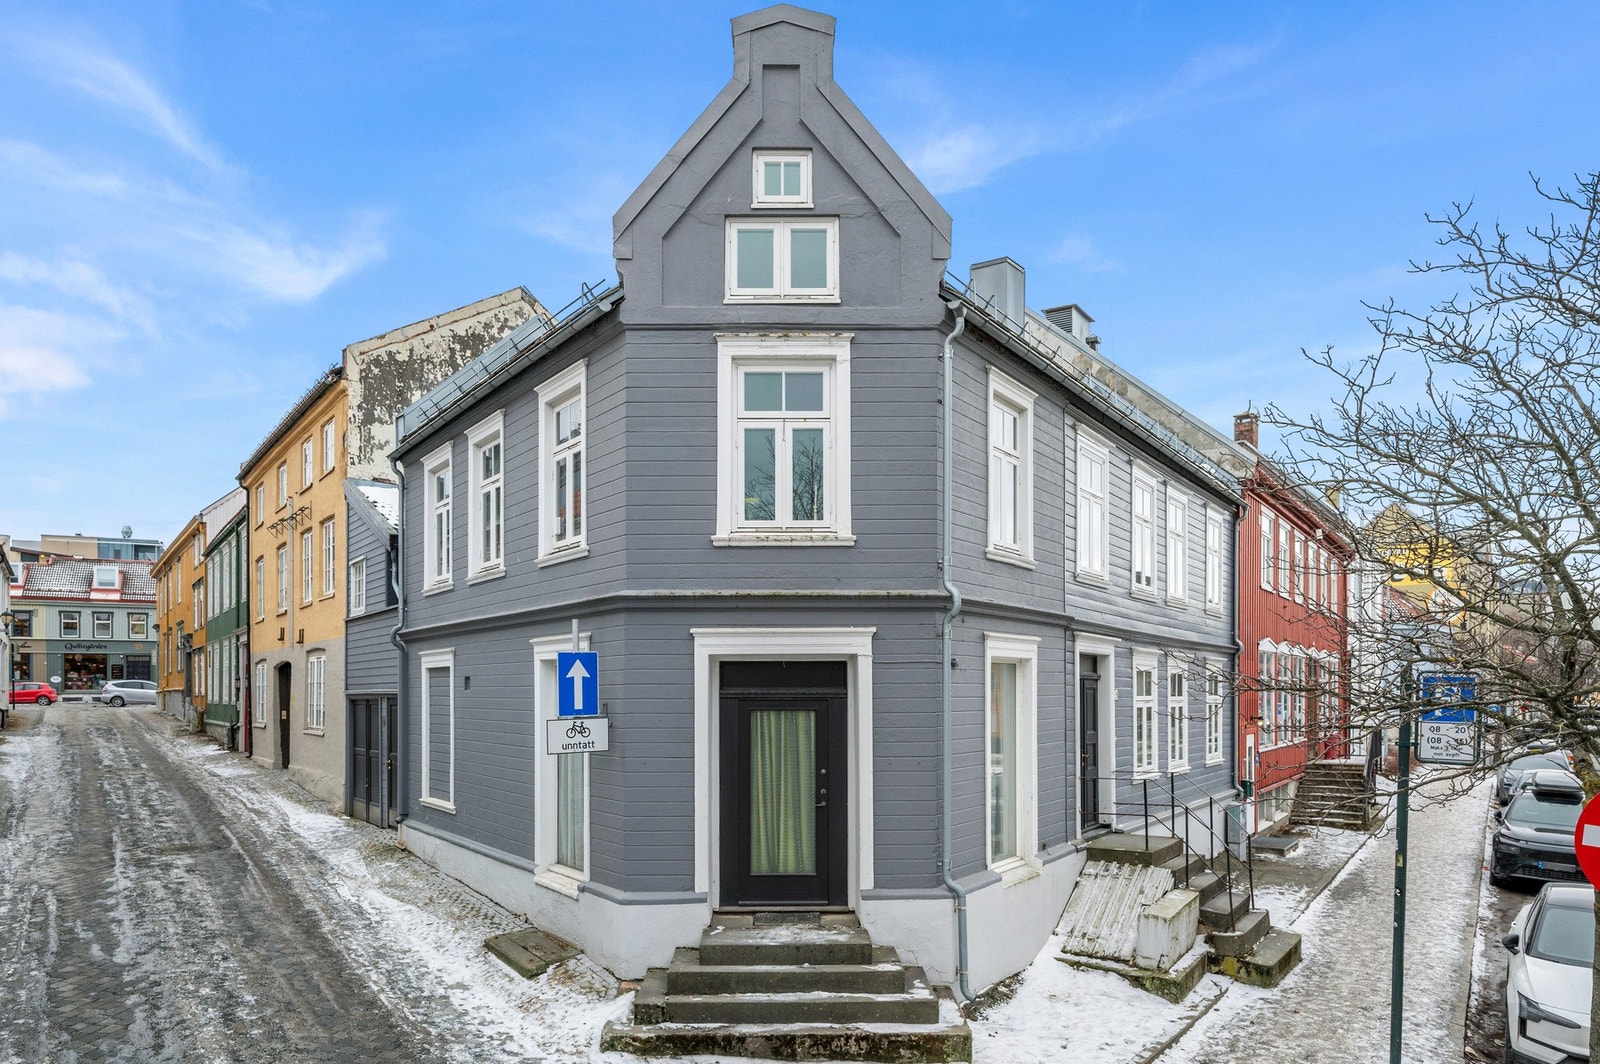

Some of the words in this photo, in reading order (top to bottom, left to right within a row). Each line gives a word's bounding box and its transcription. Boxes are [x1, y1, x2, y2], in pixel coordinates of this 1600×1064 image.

[1429, 725, 1441, 733] 08
[1455, 726, 1466, 734] 20
[561, 740, 595, 750] unntatt
